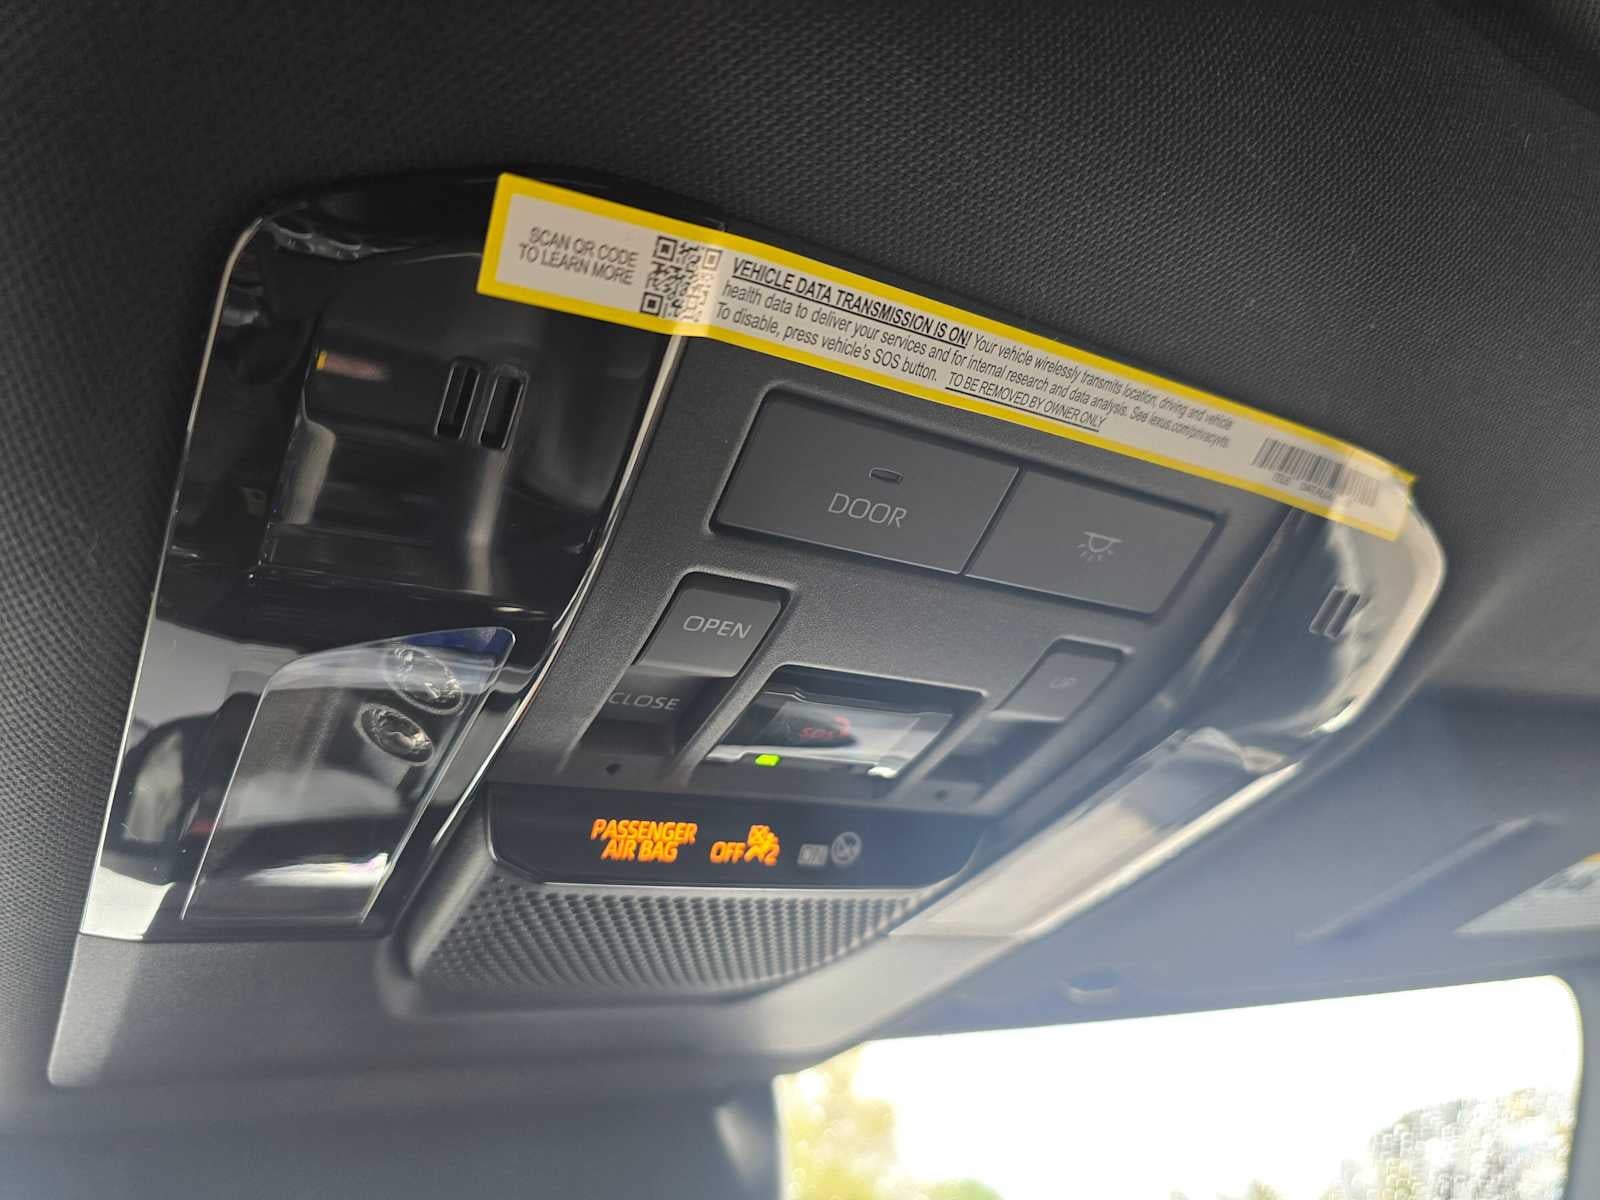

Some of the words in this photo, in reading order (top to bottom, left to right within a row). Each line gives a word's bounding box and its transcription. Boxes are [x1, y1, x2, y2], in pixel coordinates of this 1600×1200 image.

[518, 241, 540, 263] TO
[541, 248, 592, 275] LEARN
[592, 261, 636, 286] MORE
[529, 226, 571, 250] SCAN
[598, 244, 639, 268] CODE
[732, 257, 795, 289] VEHICLE
[795, 278, 832, 303] DATA
[835, 287, 933, 335] TRANSMISSION
[933, 320, 947, 338] IS
[948, 326, 973, 346] ON!
[973, 330, 999, 355] Your
[999, 341, 1033, 367] vehicle
[1034, 356, 1081, 384] wirelessly
[1080, 369, 1122, 396] transmits
[715, 301, 731, 321] To
[734, 307, 781, 337] disable,
[783, 324, 818, 345] press
[821, 333, 871, 361] vehicle's
[872, 348, 901, 369] SOS
[902, 359, 938, 382] button.
[949, 371, 963, 388] TO
[963, 376, 980, 391] BE
[979, 380, 1030, 407] REMOVED
[1029, 391, 1045, 409] BY
[1044, 399, 1081, 421] OWNER
[721, 279, 763, 302] health
[764, 291, 793, 315] data
[796, 301, 809, 319] to
[811, 306, 853, 332] deliver
[850, 322, 881, 340] your
[881, 329, 927, 355] services
[928, 344, 951, 363] and
[950, 349, 968, 367] for
[967, 356, 1006, 379] internal
[1005, 368, 1050, 394] research
[1049, 378, 1070, 398] and
[1069, 388, 1091, 405] data
[1129, 406, 1149, 423] See
[827, 492, 908, 529] DOOR
[682, 614, 753, 640] OPEN
[608, 691, 681, 711] CLOSE
[590, 817, 699, 845] PASSENGER
[600, 838, 638, 862] AIR
[638, 840, 679, 864] BAG
[709, 840, 746, 865] OFF
